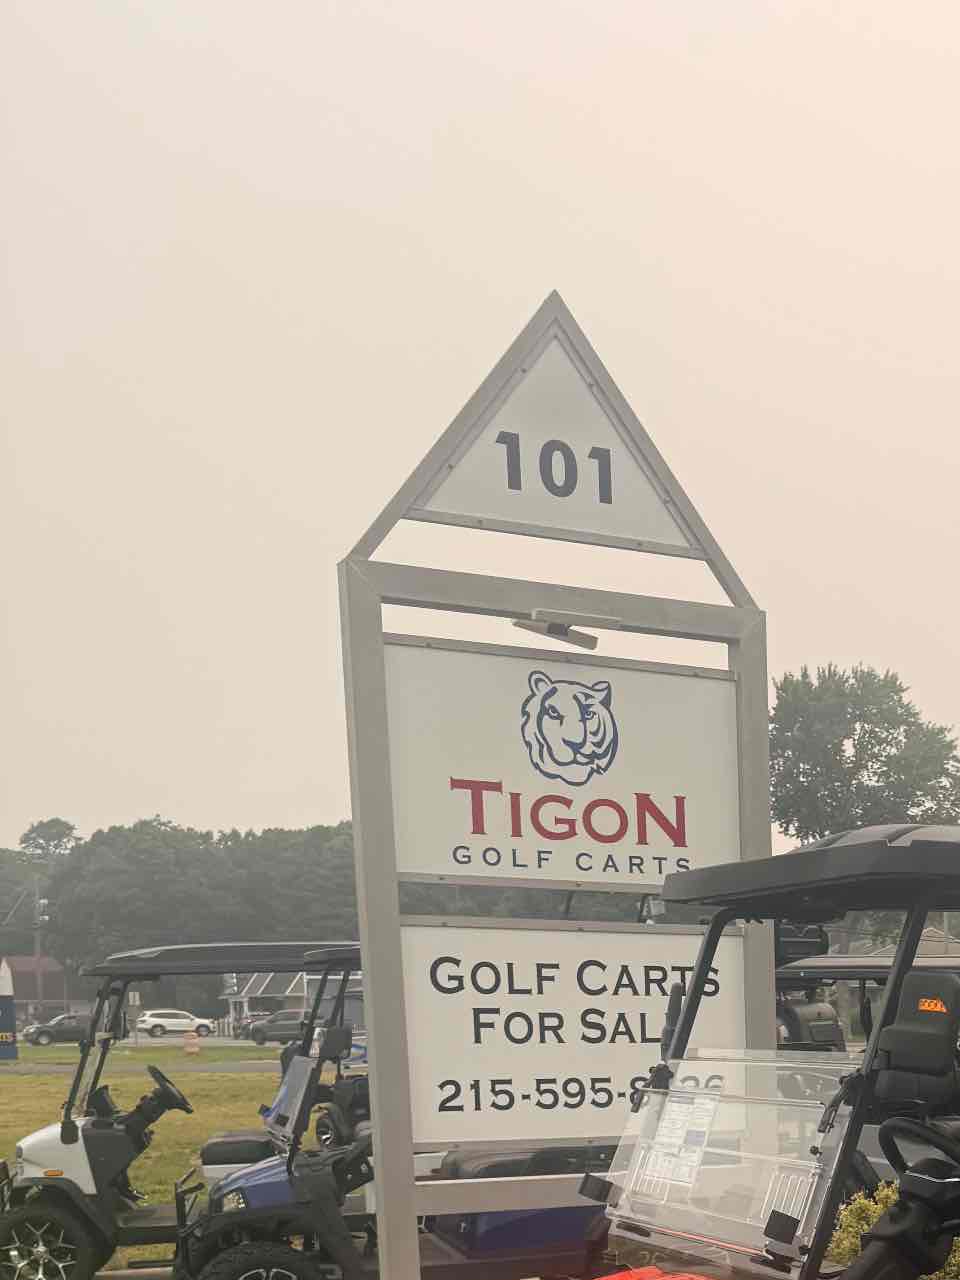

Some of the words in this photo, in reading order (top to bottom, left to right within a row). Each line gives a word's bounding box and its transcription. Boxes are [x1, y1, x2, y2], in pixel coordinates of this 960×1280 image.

[495, 430, 612, 505] 101
[449, 777, 688, 848] TIGON
[452, 845, 553, 869] GOLF
[575, 852, 690, 875] CARTS
[429, 956, 560, 995] GOLF
[576, 959, 720, 997] CARTS
[472, 1007, 567, 1044] FOR
[580, 1008, 664, 1044] SAL
[437, 1075, 724, 1113] 215-595-8
